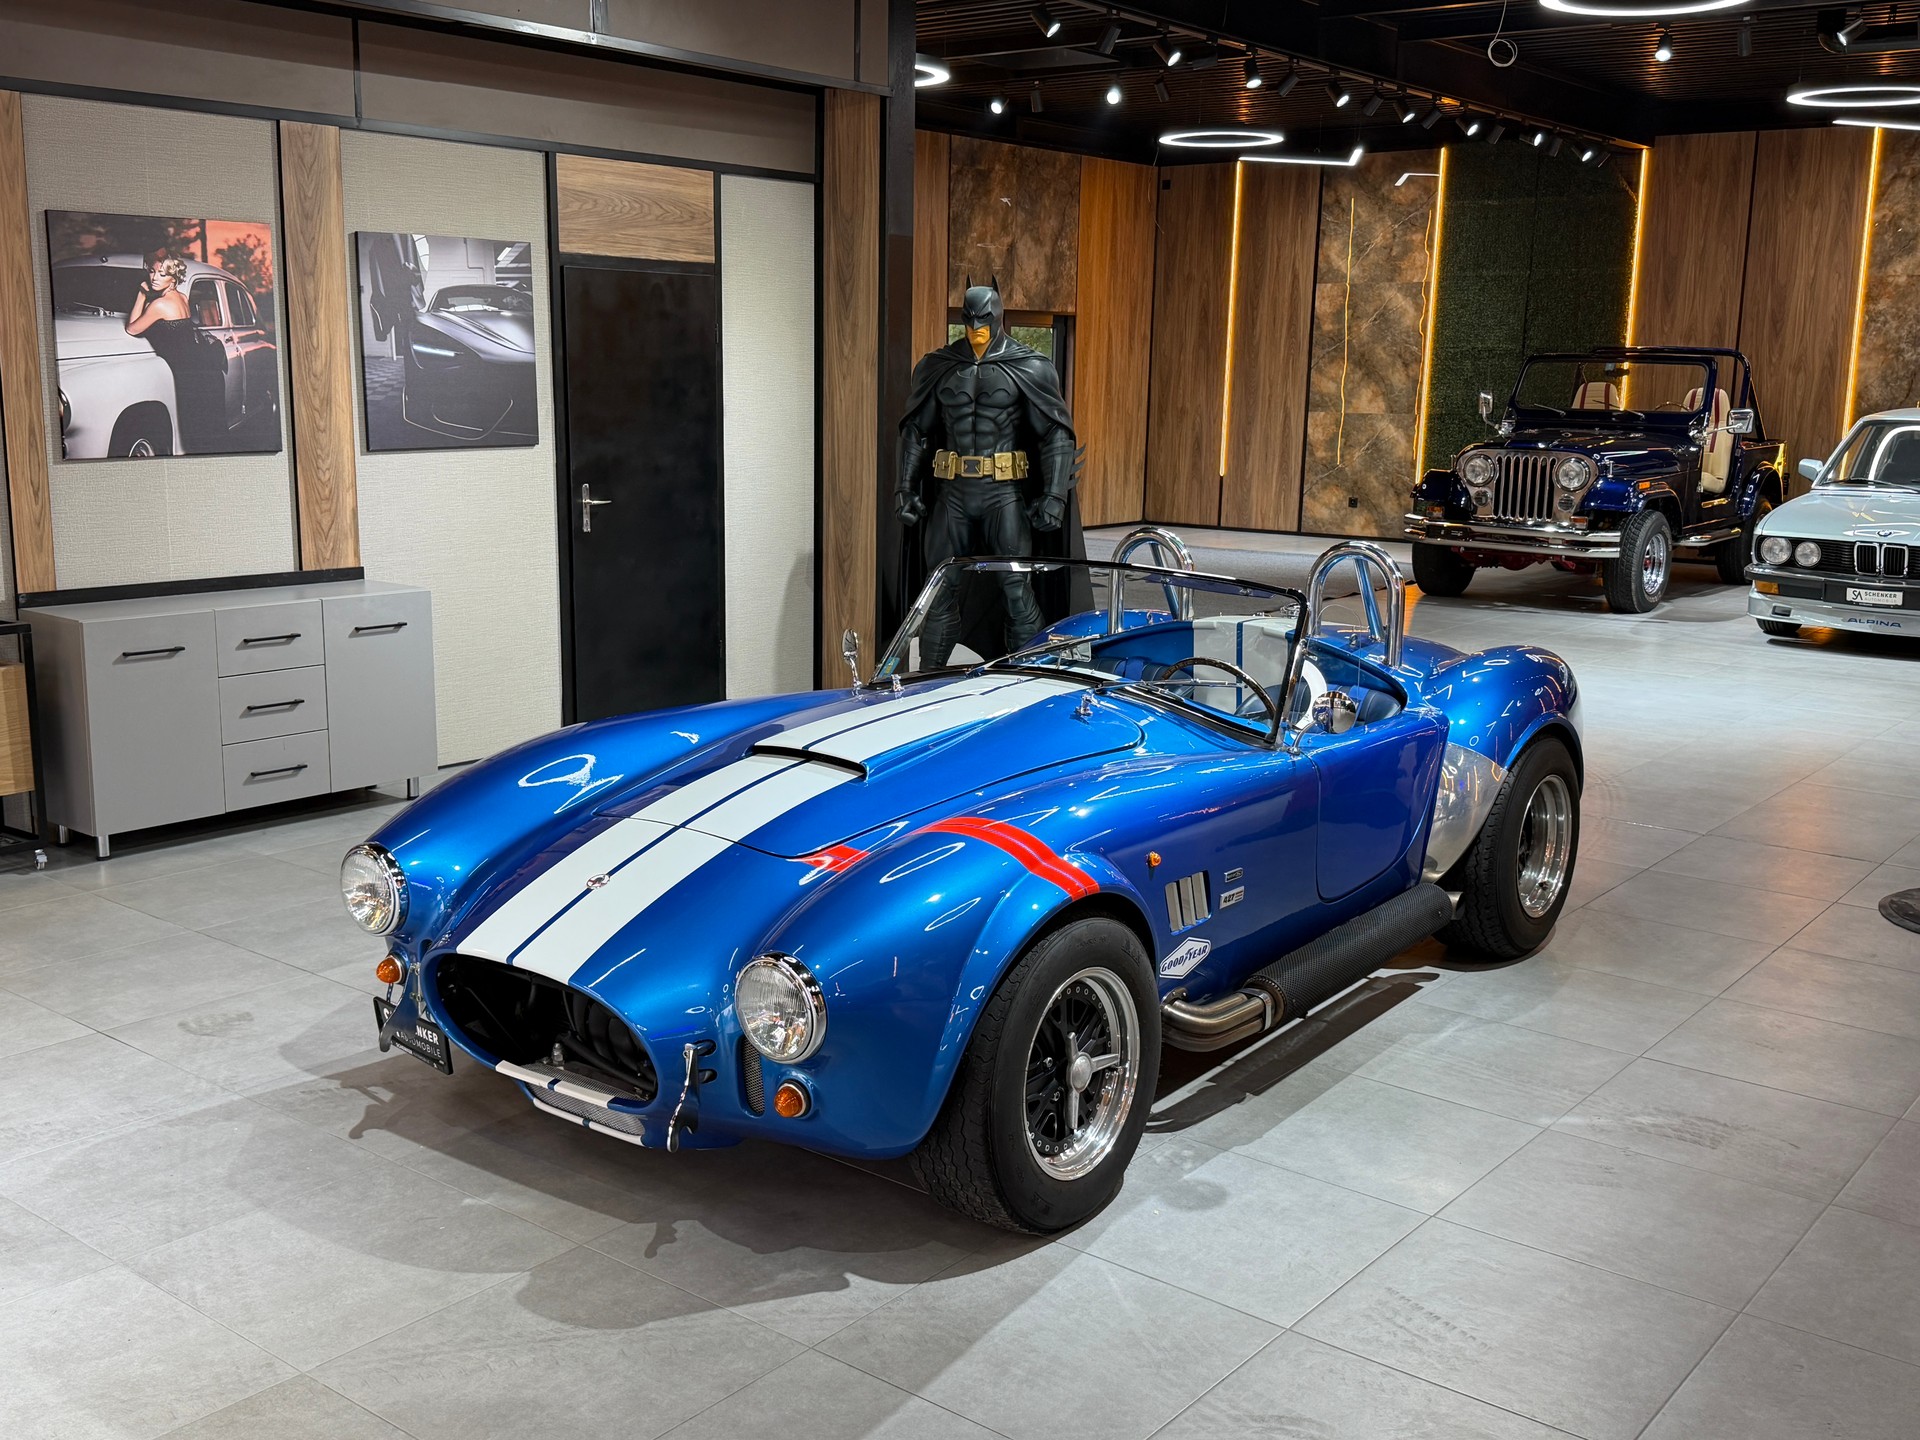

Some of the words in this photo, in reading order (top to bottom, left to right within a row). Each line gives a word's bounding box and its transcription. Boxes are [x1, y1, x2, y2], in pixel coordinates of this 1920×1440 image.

[1864, 591, 1898, 599] SCHENKER
[1847, 617, 1902, 628] ALPINA
[1223, 892, 1236, 904] 427
[1161, 944, 1208, 972] GOODYEAR
